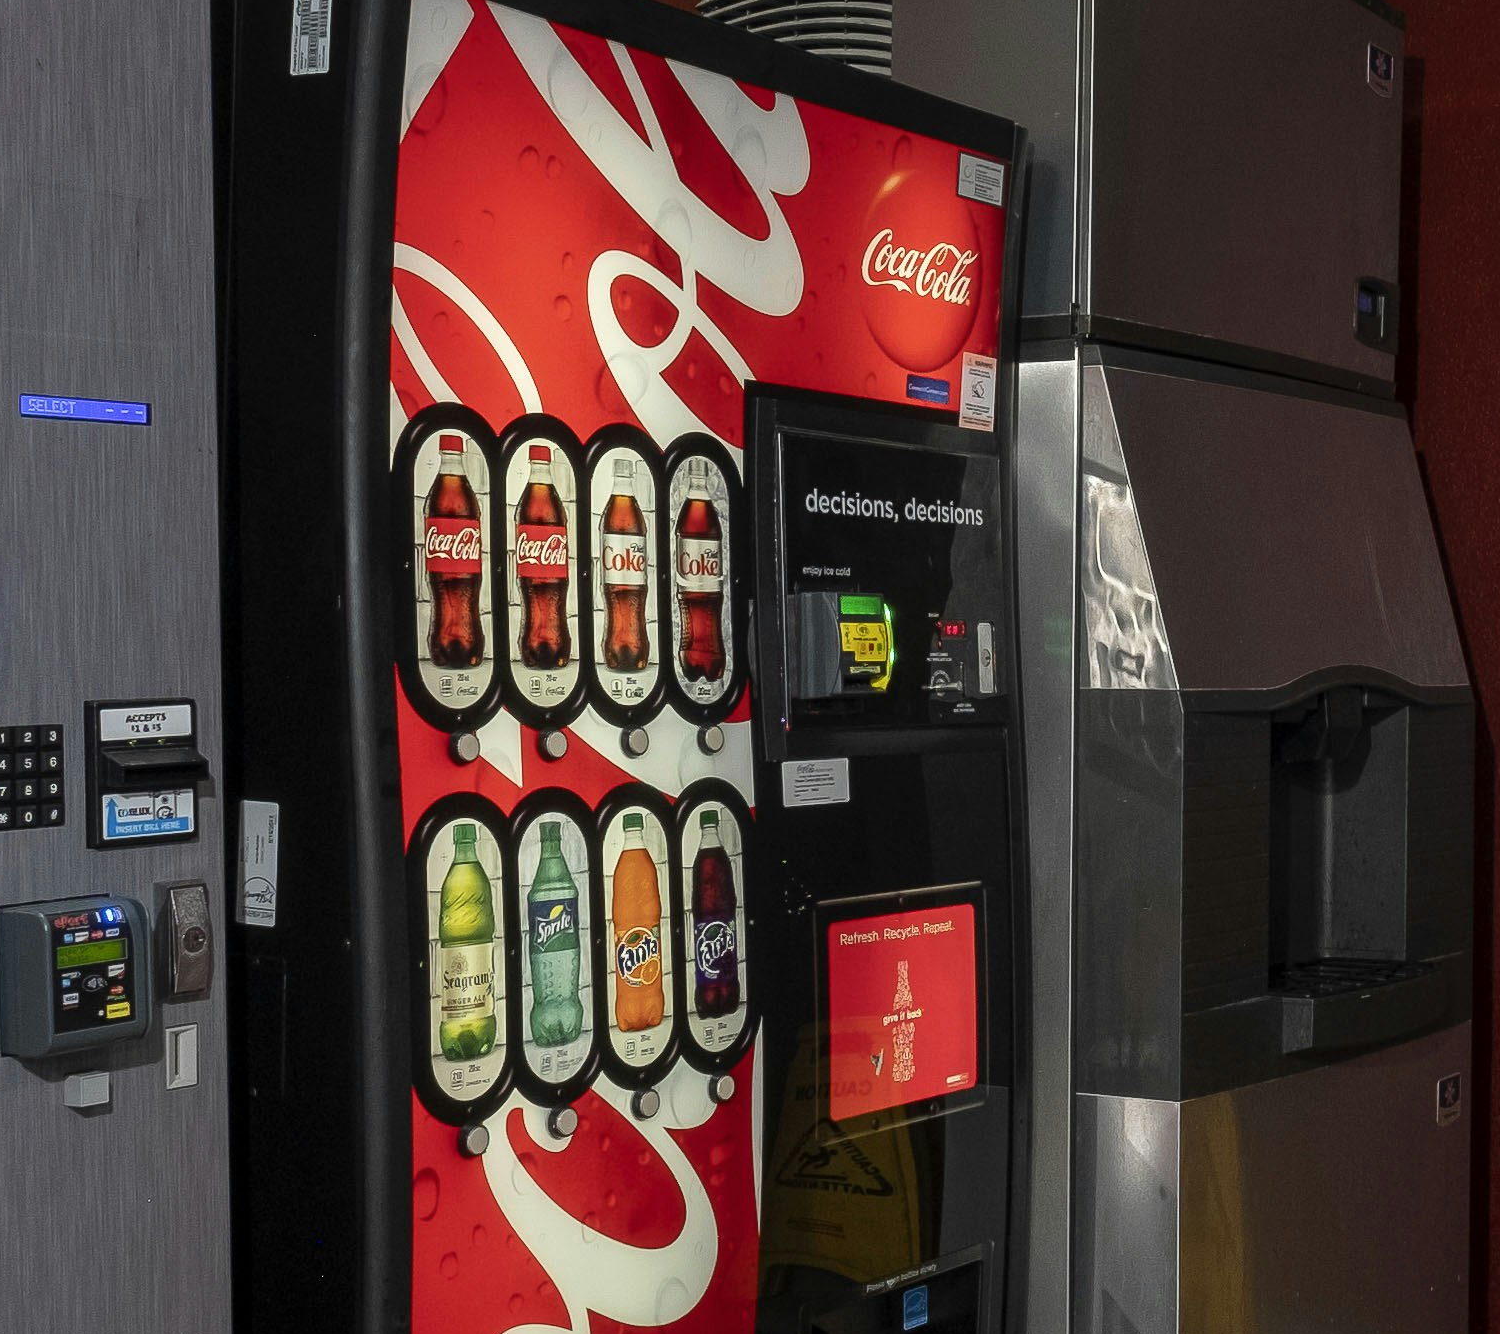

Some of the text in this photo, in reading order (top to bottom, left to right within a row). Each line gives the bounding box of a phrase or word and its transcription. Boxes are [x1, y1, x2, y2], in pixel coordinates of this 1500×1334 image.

[860, 227, 979, 307] Coca-Cola
[27, 398, 77, 415] SELECT
[805, 488, 984, 526] decisions, decisions
[425, 526, 481, 562] Coca-Cola
[516, 530, 568, 566] Coca-Cola
[602, 545, 646, 573] Coke
[678, 553, 719, 577] Coke
[835, 566, 851, 577] cold
[125, 712, 168, 724] ACCEPTS
[536, 916, 574, 943] Sprite
[618, 935, 659, 979] Fanta
